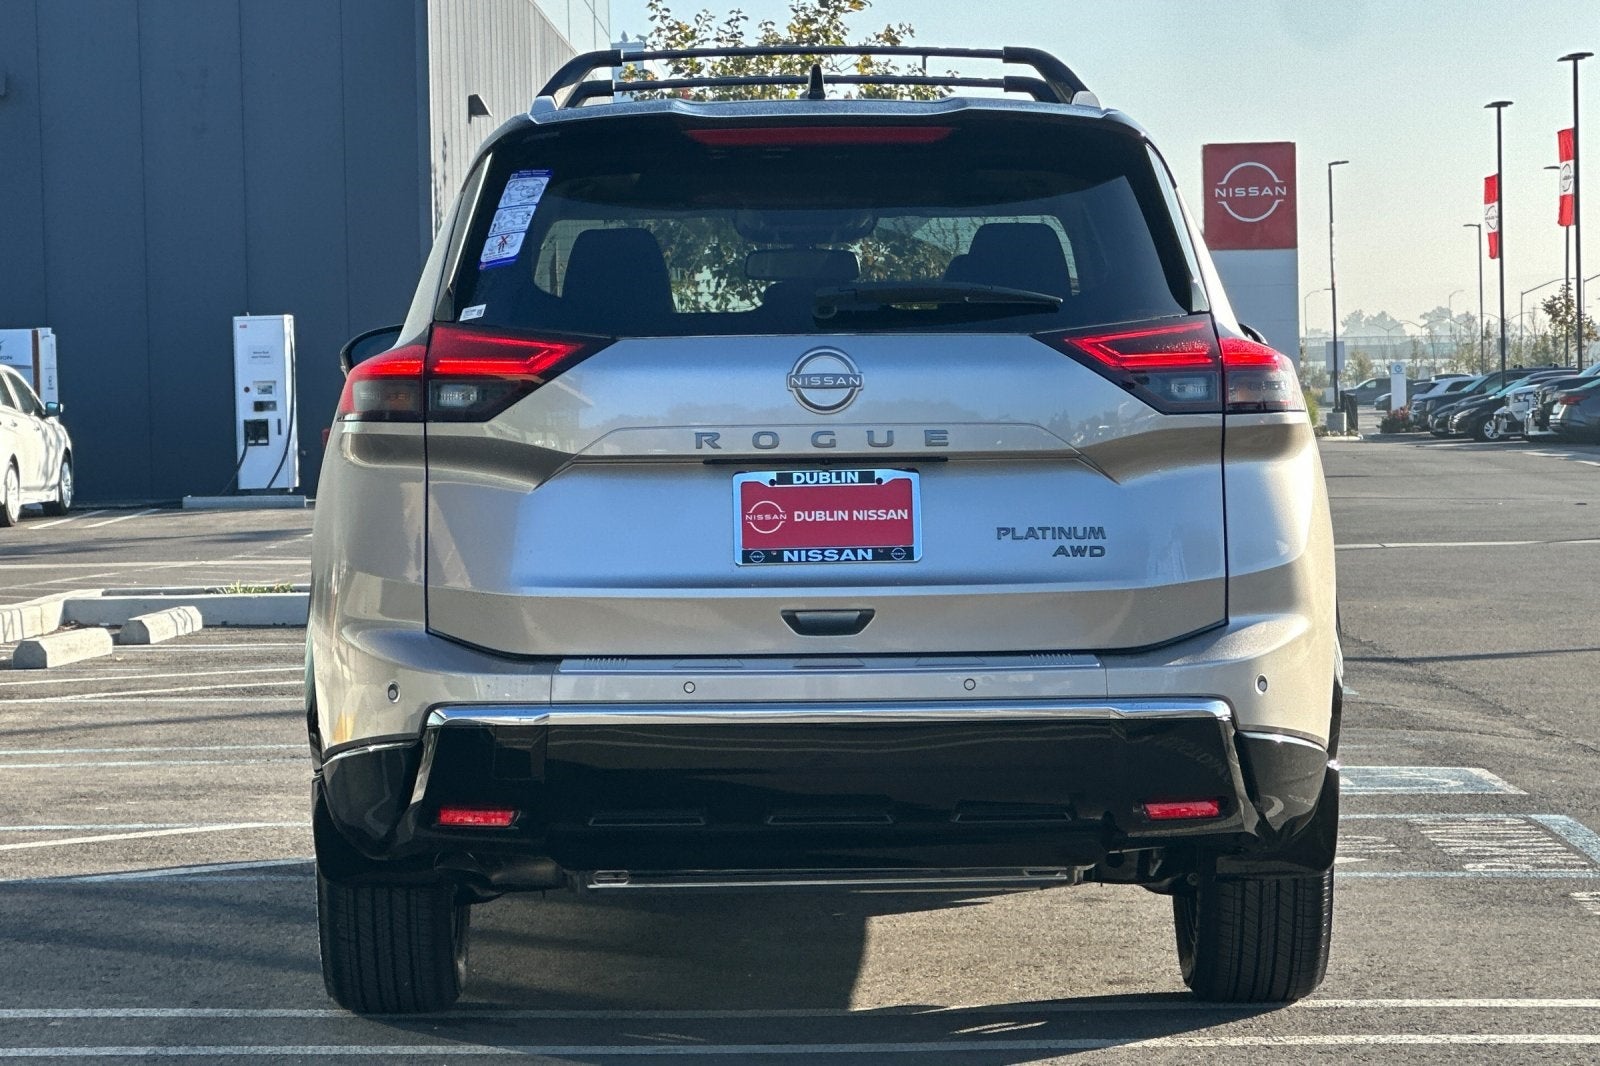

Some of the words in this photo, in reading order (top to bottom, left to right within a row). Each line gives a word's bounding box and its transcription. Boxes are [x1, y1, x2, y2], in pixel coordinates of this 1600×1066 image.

[1215, 186, 1287, 198] NISSAN
[791, 376, 861, 386] NISSAN
[694, 429, 949, 450] ROGUE
[792, 472, 859, 484] DUBLIN
[793, 511, 849, 522] DUBLIN
[852, 509, 908, 521] NISSAN
[996, 526, 1107, 540] PLATINUM
[783, 549, 873, 562] NISSAN
[1052, 545, 1106, 557] AWD
